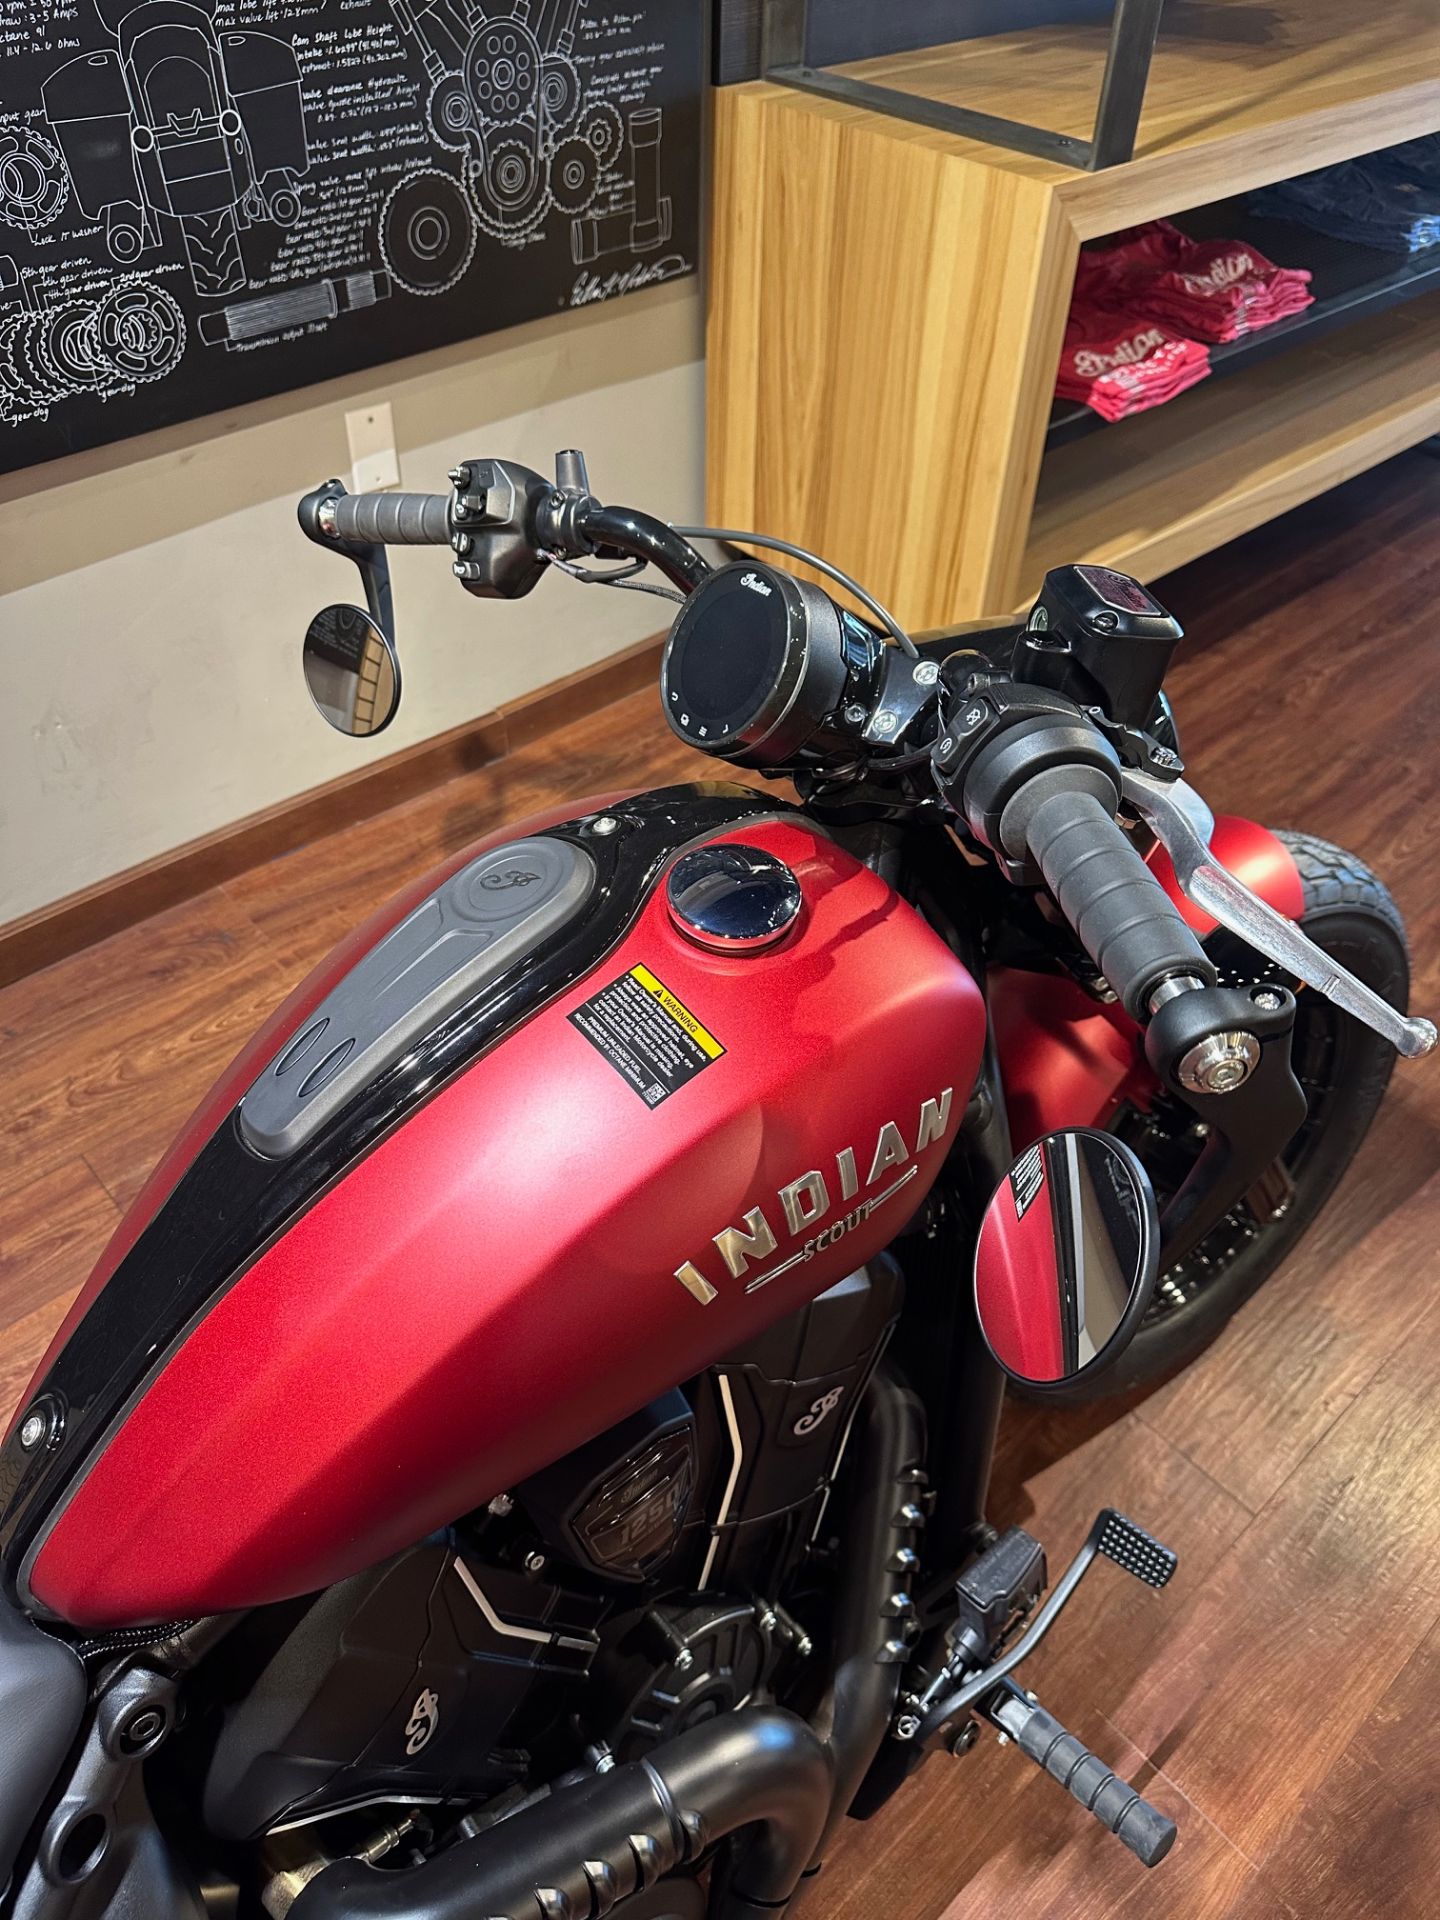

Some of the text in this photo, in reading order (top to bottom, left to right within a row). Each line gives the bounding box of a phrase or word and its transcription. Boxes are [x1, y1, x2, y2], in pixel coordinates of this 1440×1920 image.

[36, 25, 45, 37] 91
[53, 7, 78, 20] Amps
[366, 23, 394, 37] Height
[39, 265, 58, 280] gear
[61, 257, 92, 270] driven
[60, 273, 79, 289] gear
[81, 265, 113, 279] driven
[84, 279, 111, 291] driven
[155, 263, 185, 275] driven
[33, 407, 49, 422] dog
[740, 573, 772, 597] Indian
[593, 1002, 601, 1010] for
[602, 1013, 630, 1042] replacement.
[606, 998, 619, 1009] your
[617, 1007, 635, 1027] Owner's
[633, 1025, 652, 1044] Manual
[608, 990, 632, 1012] protection
[630, 1011, 641, 1021] and
[638, 1020, 662, 1044] protective
[615, 986, 632, 1002] Always
[630, 1001, 642, 1013] wear
[646, 1018, 669, 1041] approved
[683, 1058, 694, 1068] eye
[627, 977, 641, 990] Read
[638, 988, 657, 1008] Owner's
[655, 1005, 674, 1024] Manual
[681, 1034, 697, 1051] during
[639, 999, 654, 1014] safety
[651, 1013, 679, 1042] precautions.
[663, 996, 697, 1032] WARNING
[573, 1012, 605, 1045] RECOMMENDED
[607, 1048, 627, 1069] OCTANE
[587, 1015, 609, 1038] PREMIUM
[606, 1035, 631, 1061] UNLEADED
[598, 999, 616, 1016] contact
[619, 1020, 634, 1036] Indian
[632, 1034, 658, 1062] Motorcycle
[656, 1061, 673, 1077] dealer
[673, 1087, 952, 1306] INDIAN
[802, 1197, 872, 1262] SCOUT
